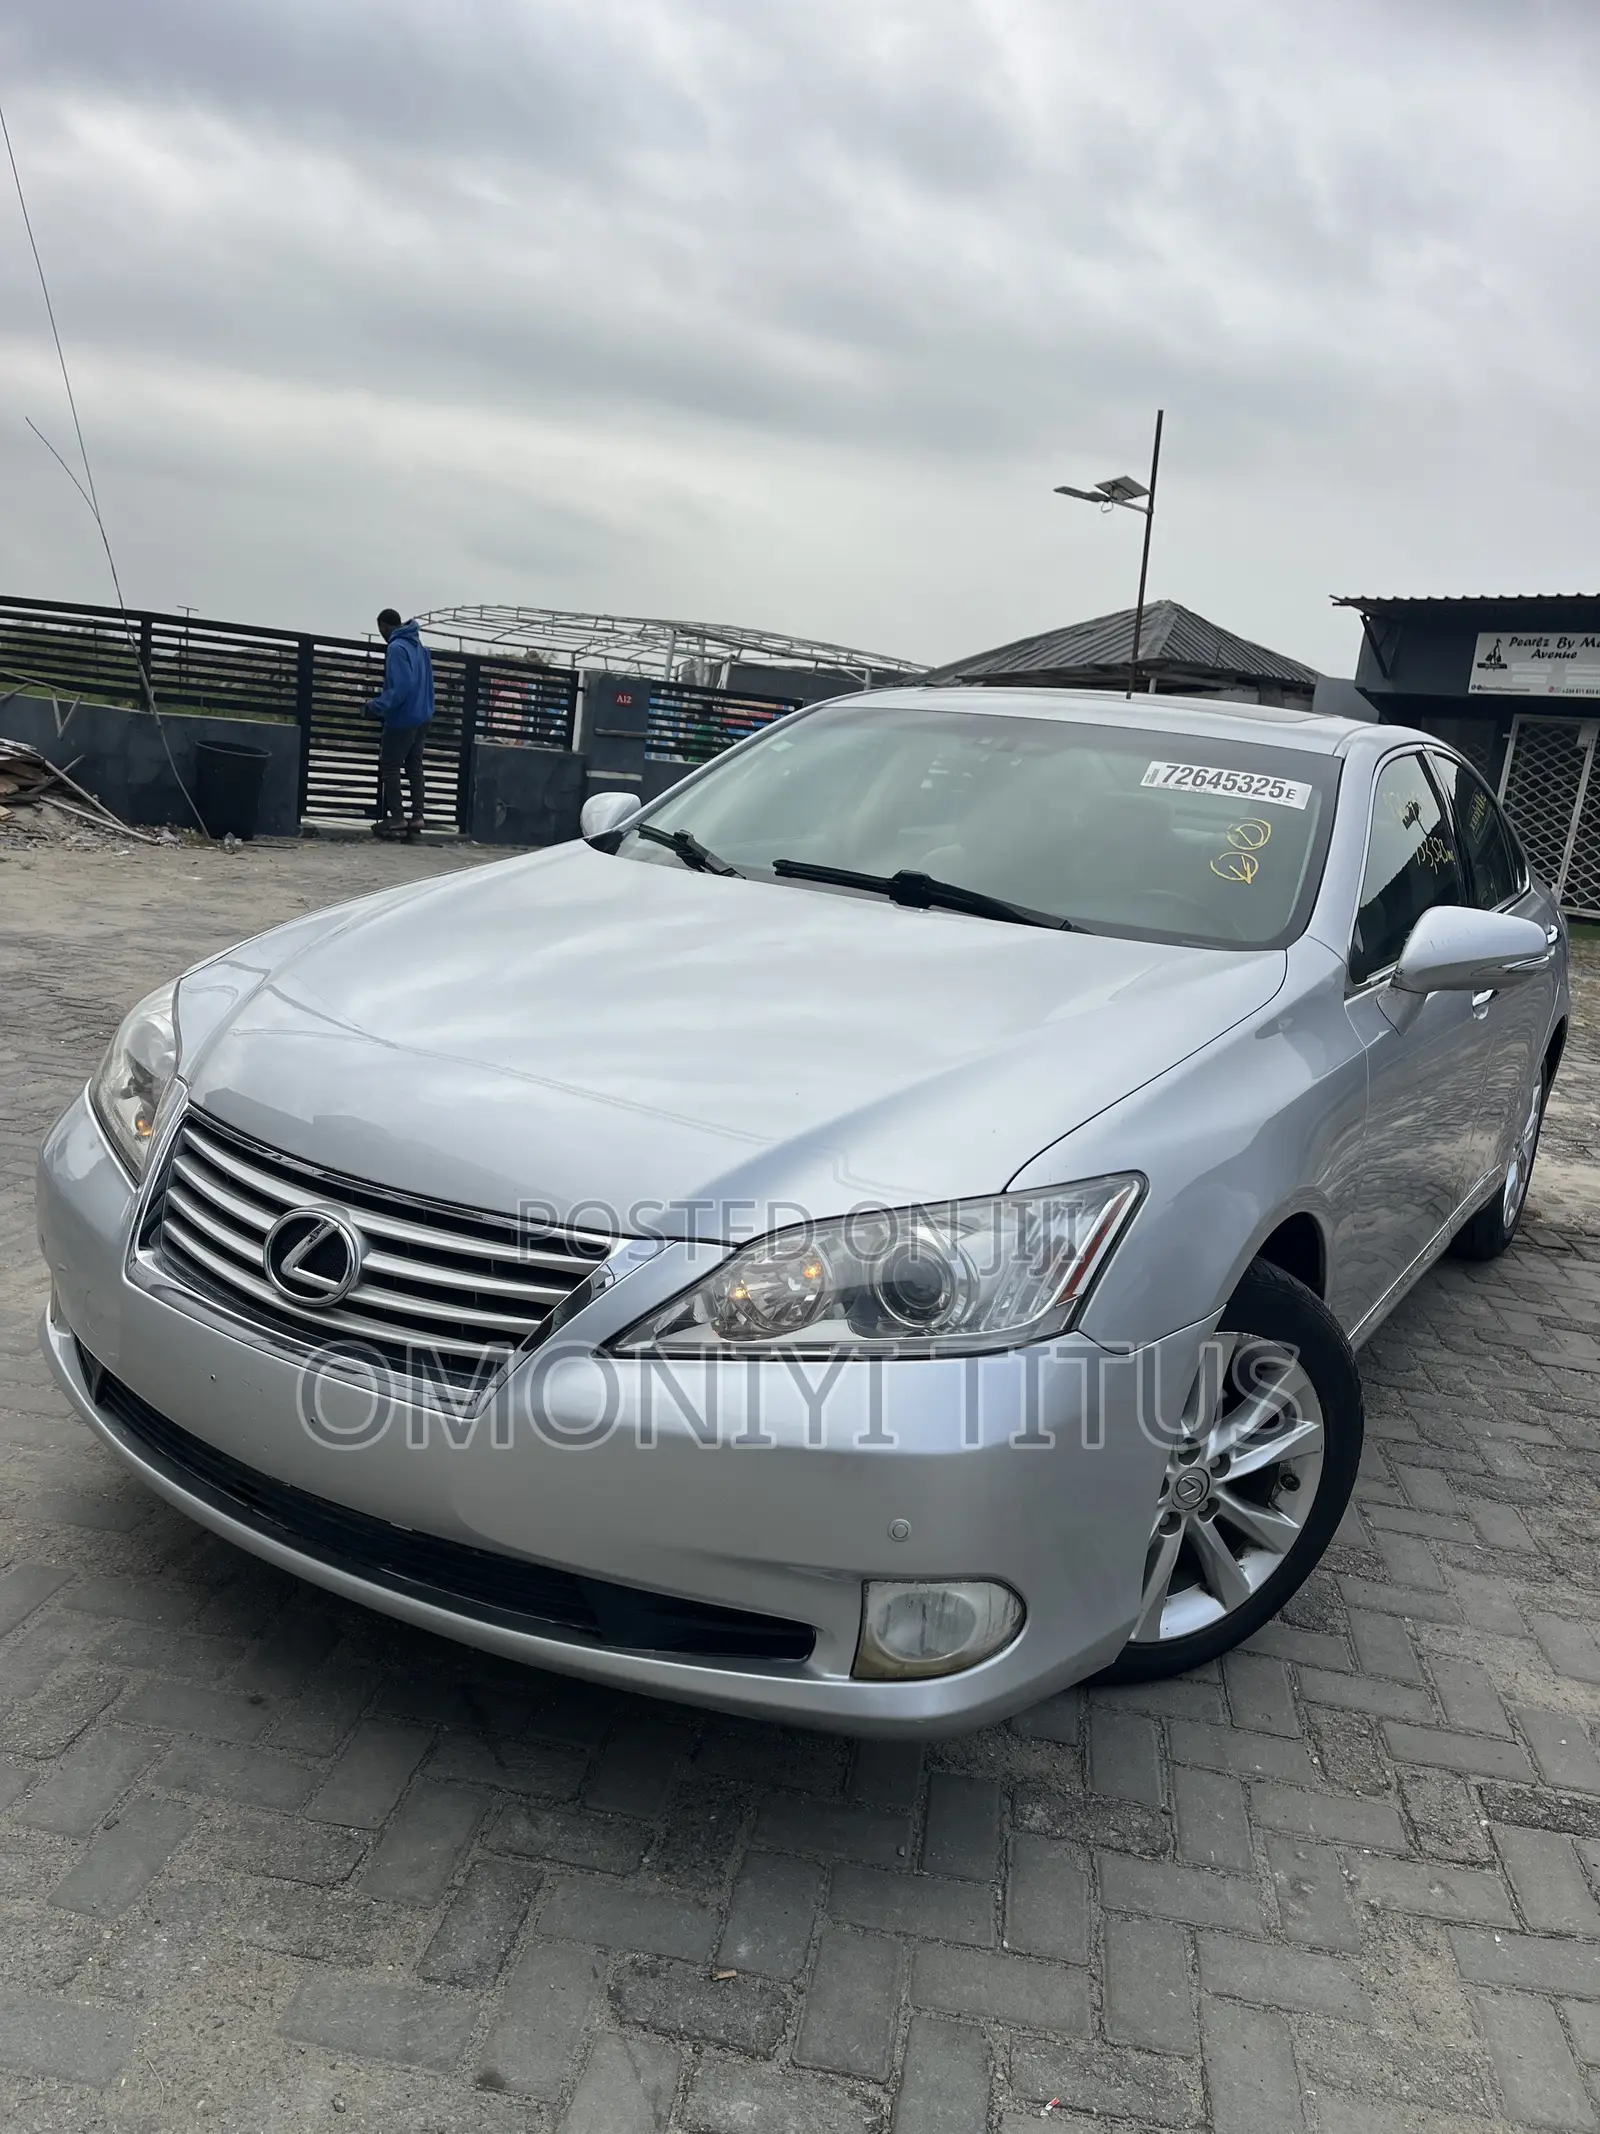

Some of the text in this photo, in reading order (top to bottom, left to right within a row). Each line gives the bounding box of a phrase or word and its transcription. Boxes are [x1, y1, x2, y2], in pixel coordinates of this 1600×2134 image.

[1556, 636, 1576, 649] By
[1531, 648, 1578, 660] Avenue
[616, 694, 632, 704] A12
